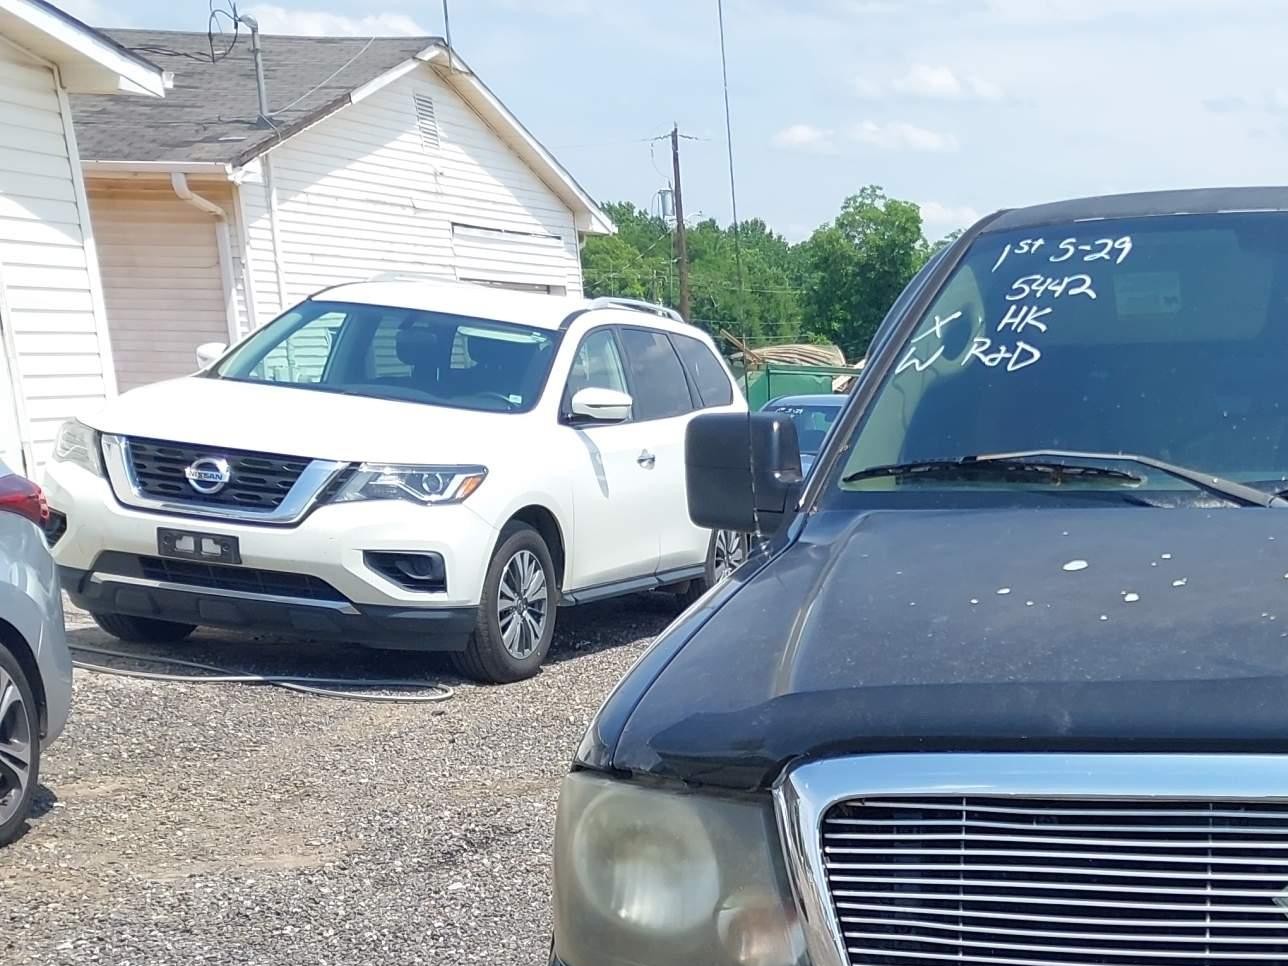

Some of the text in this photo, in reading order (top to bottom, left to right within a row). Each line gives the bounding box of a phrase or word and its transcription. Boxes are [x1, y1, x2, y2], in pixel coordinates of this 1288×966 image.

[992, 238, 1044, 272] 1st
[1005, 274, 1096, 300] 5442
[997, 305, 1052, 332] HK
[189, 470, 223, 481] NISSAN
